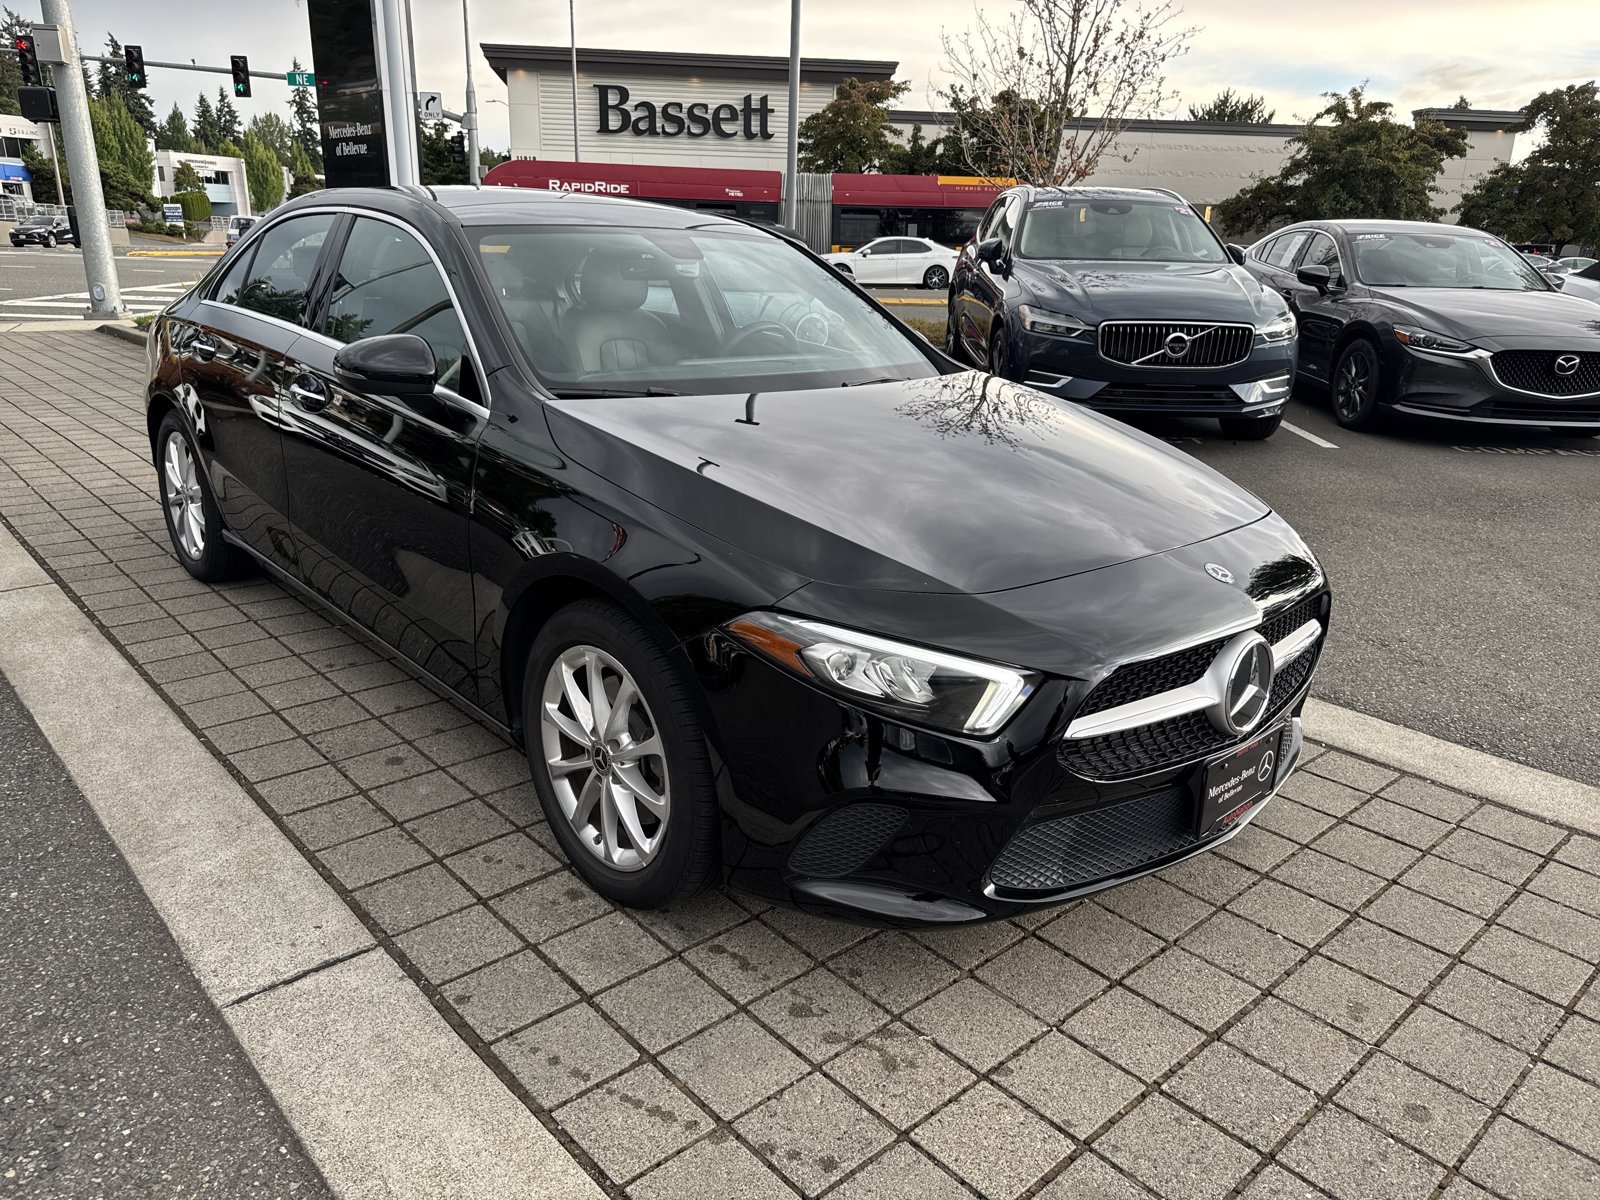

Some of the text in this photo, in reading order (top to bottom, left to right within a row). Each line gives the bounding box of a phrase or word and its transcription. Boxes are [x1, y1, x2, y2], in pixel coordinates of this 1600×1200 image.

[296, 74, 310, 86] NE
[424, 111, 441, 119] ONLY
[593, 84, 775, 140] Bassett
[328, 122, 372, 139] Mercedes-Benz
[336, 142, 368, 157] of Bellevue
[1208, 765, 1256, 799] Mercedes-Benz
[1223, 784, 1243, 801] Bellevue
